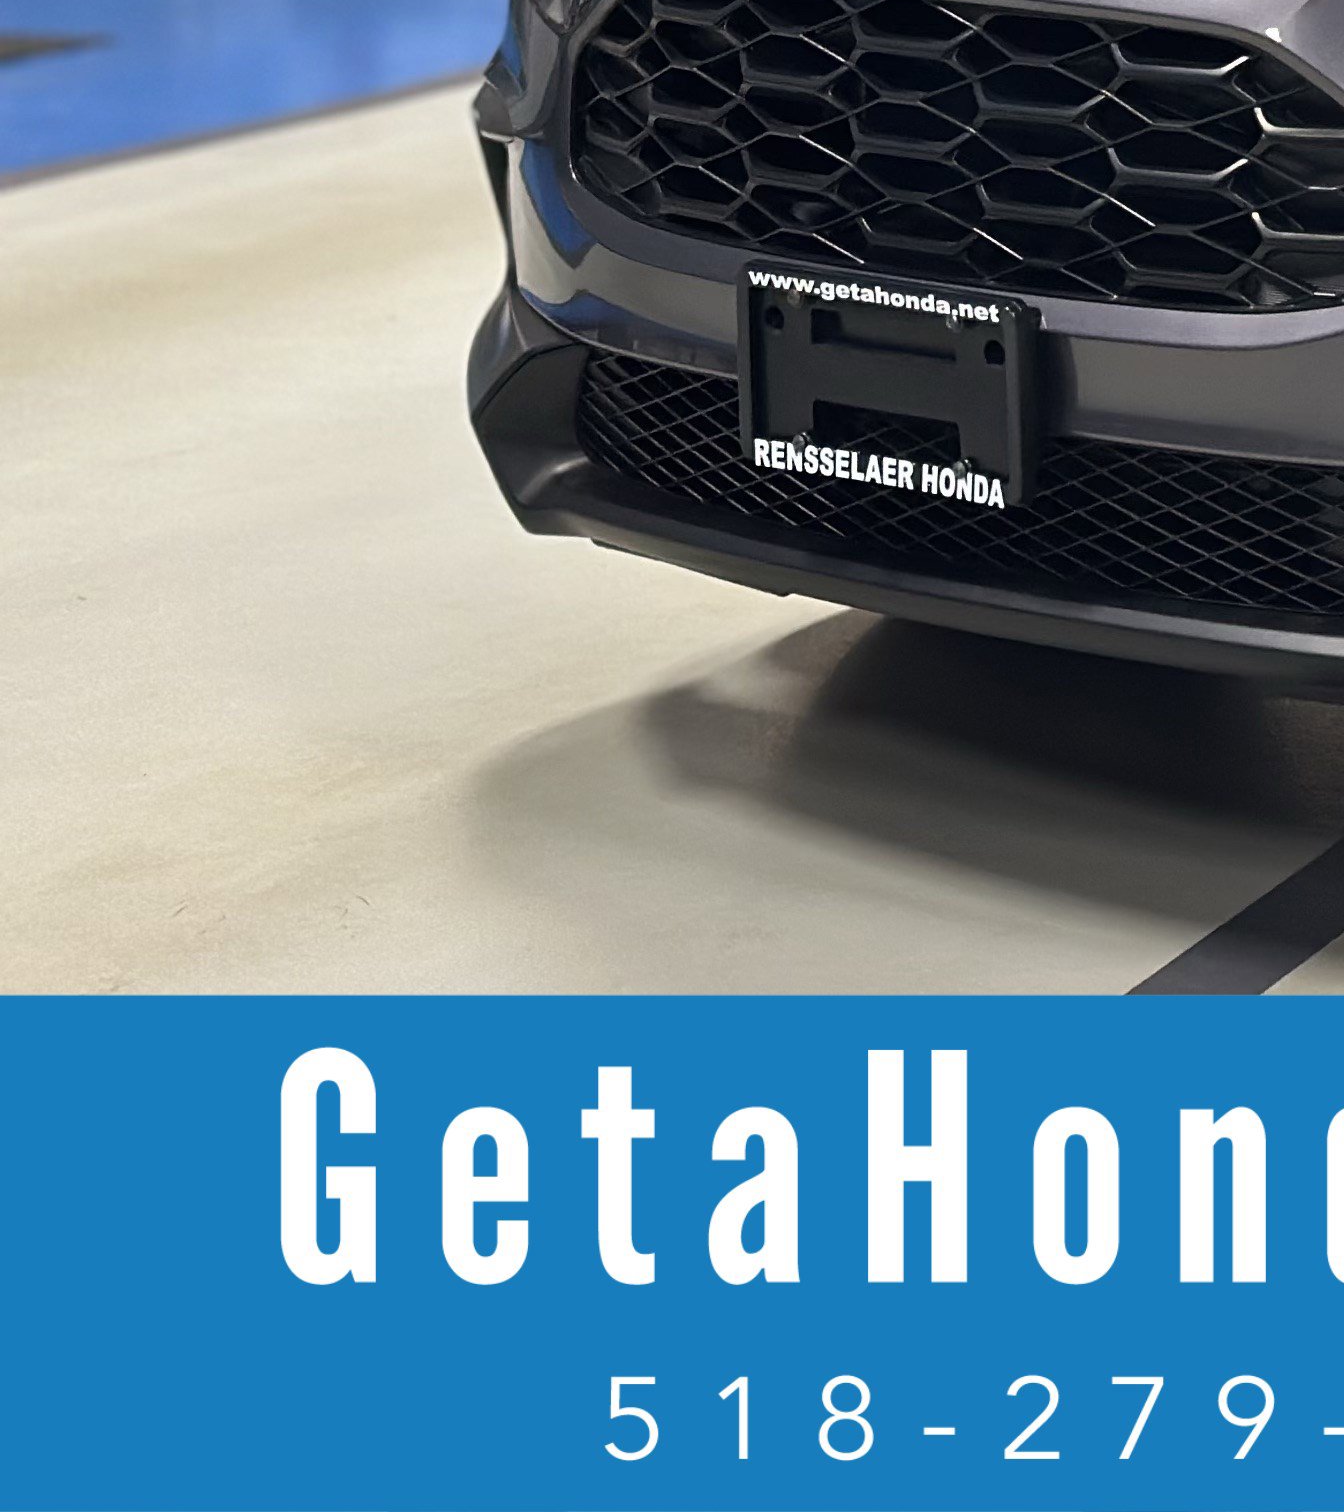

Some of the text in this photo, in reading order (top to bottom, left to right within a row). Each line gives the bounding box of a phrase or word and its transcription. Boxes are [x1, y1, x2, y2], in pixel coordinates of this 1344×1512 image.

[748, 270, 1000, 323] www.getahonda.net
[753, 437, 1005, 510] RENSSELAER HONDA
